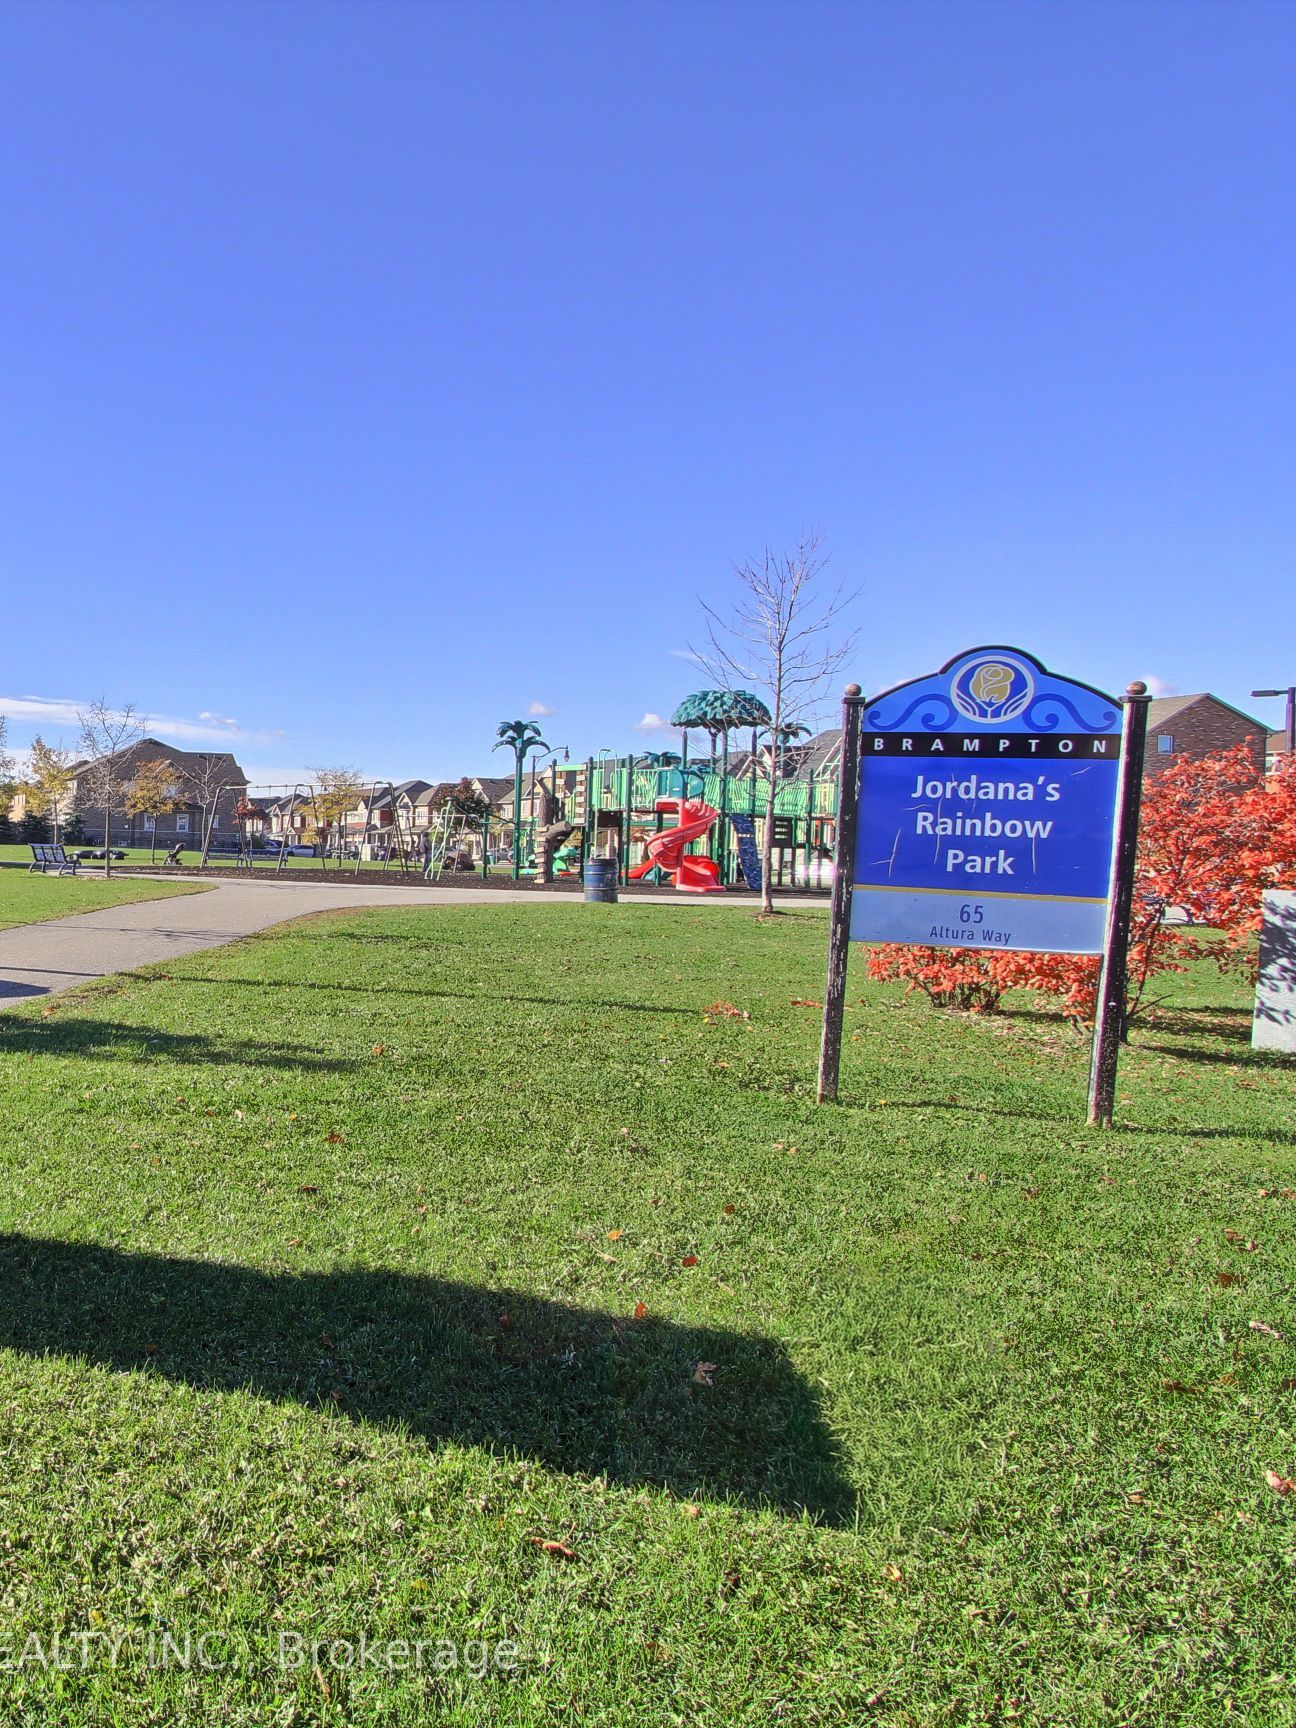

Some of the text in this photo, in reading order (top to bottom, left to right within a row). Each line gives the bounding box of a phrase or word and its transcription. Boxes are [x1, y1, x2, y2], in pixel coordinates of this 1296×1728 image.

[873, 737, 1106, 753] BRAMPTON
[911, 775, 1060, 801] Jordana's
[916, 812, 1053, 838] Rainbow
[945, 849, 1014, 875] Park
[959, 904, 984, 924] 65
[929, 925, 1011, 945] Altura Way
